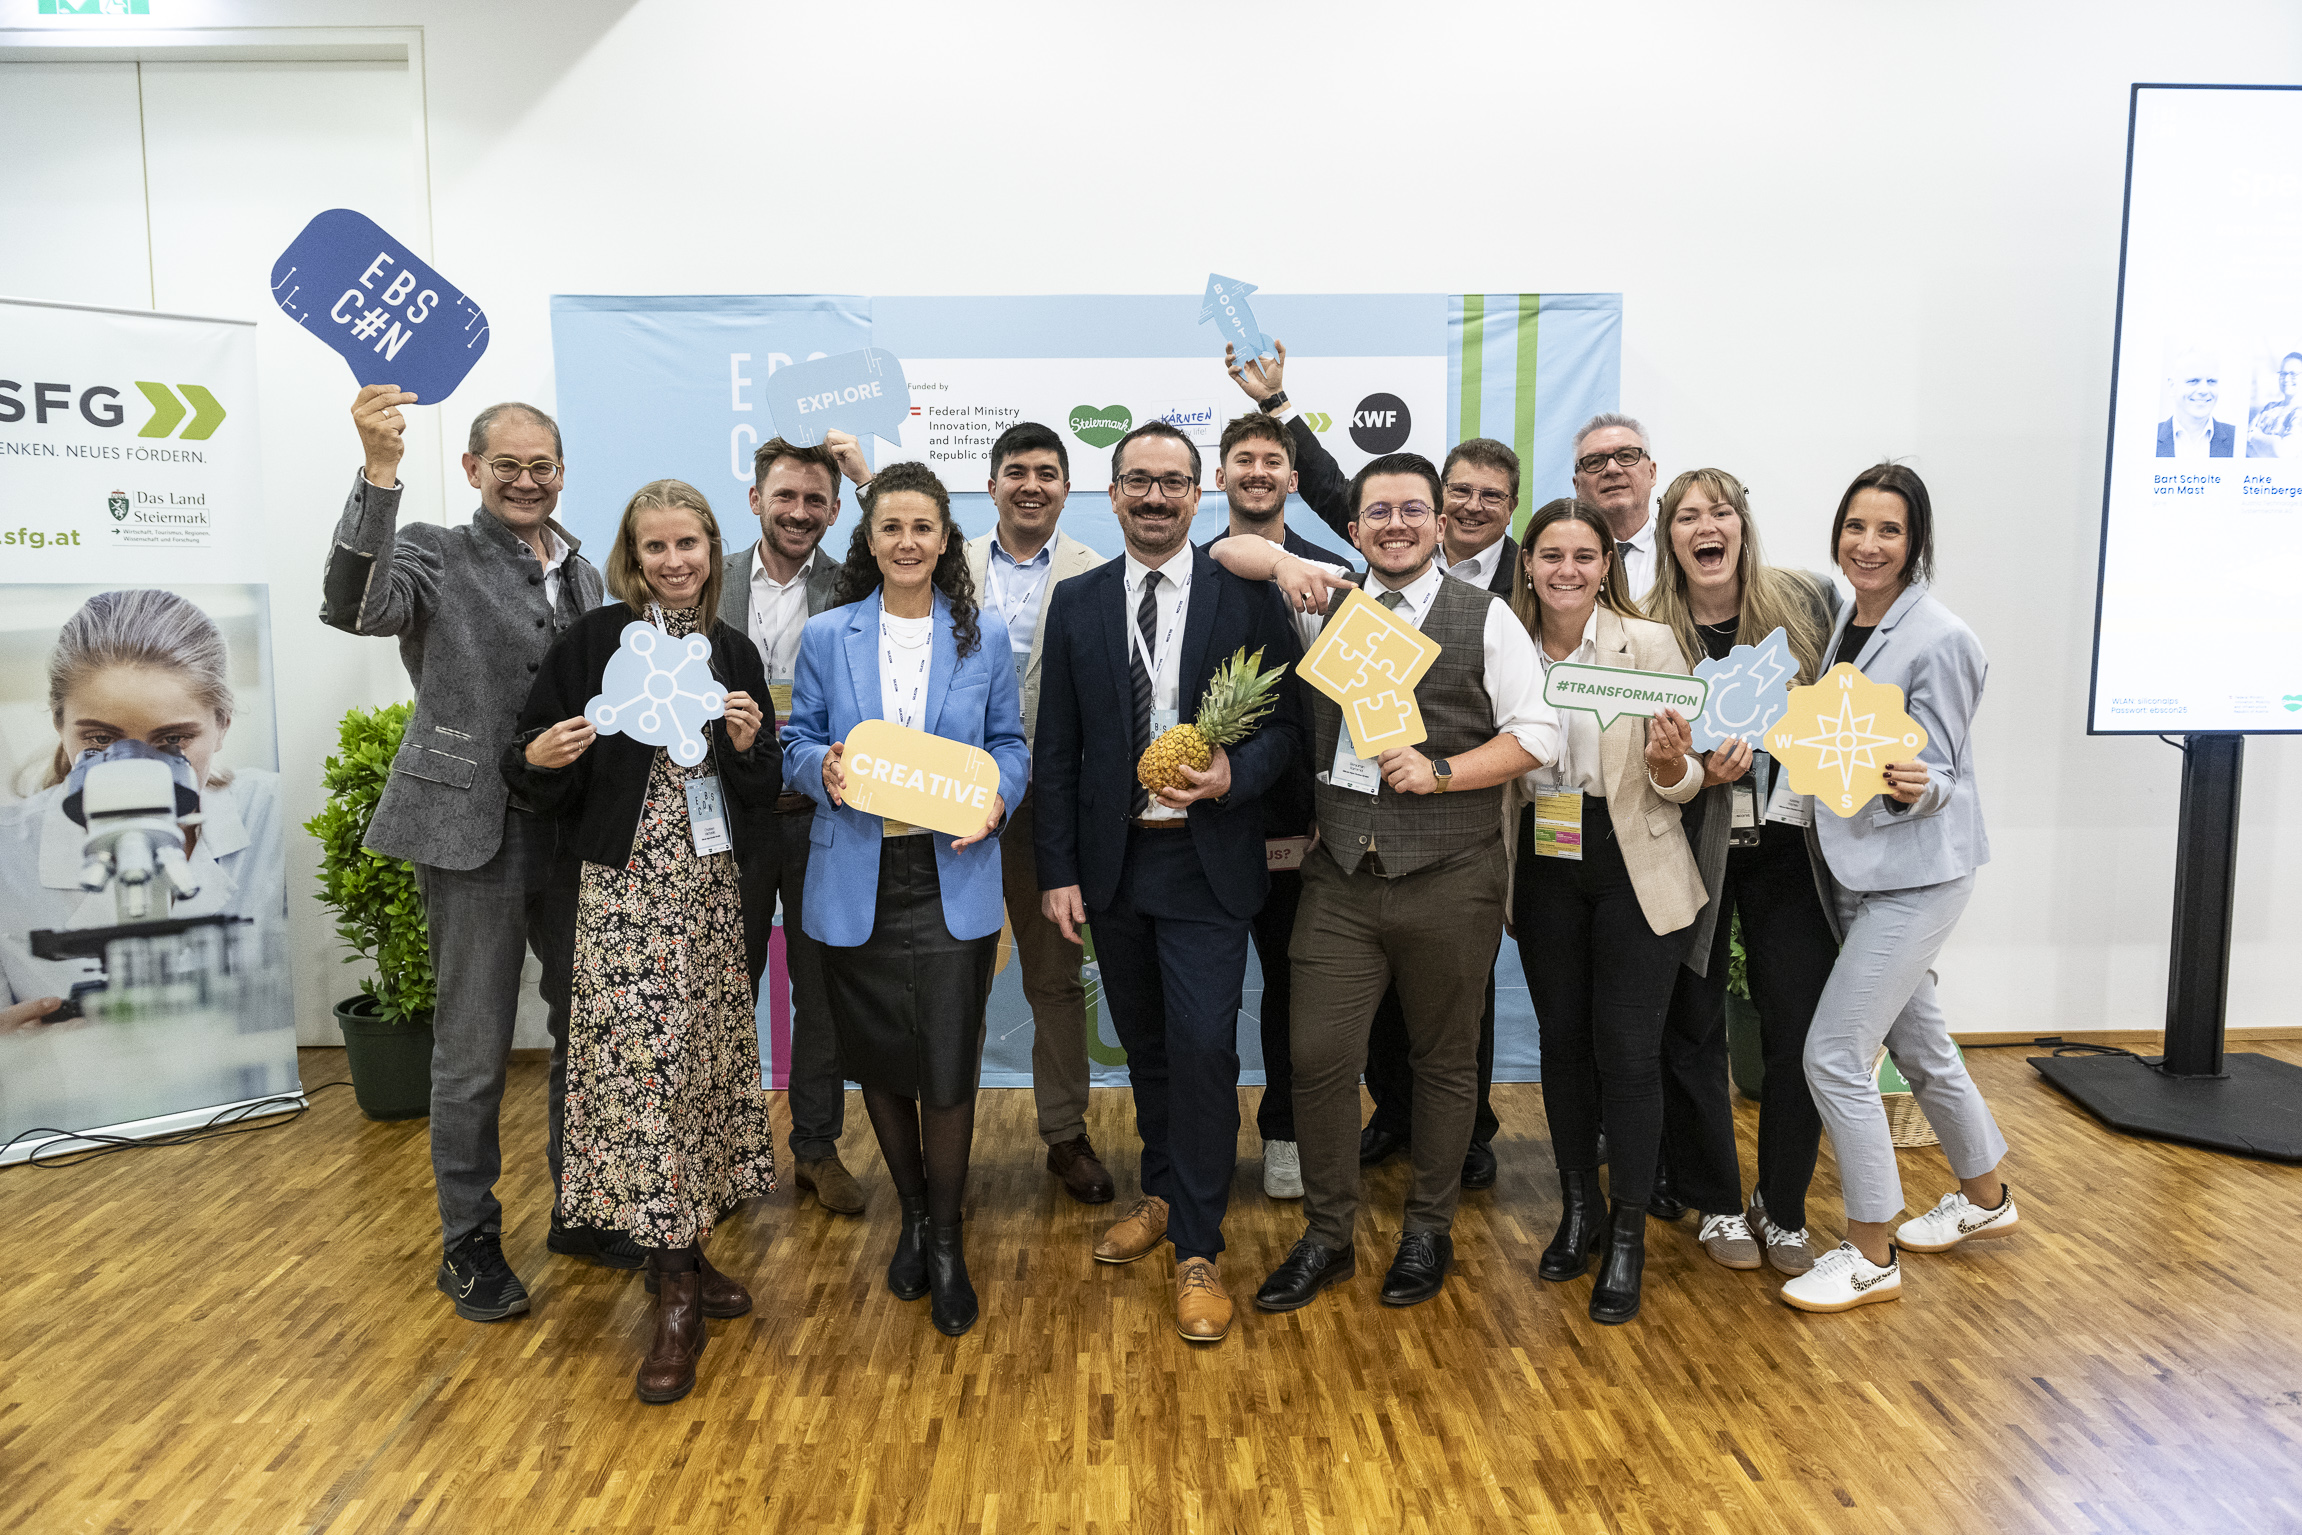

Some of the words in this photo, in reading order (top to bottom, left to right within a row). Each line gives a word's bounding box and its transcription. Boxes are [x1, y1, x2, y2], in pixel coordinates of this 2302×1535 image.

[358, 251, 439, 324] EBS
[1213, 283, 1247, 338] BOOST
[330, 288, 413, 362] C#N
[907, 382, 936, 390] Funded
[939, 382, 949, 391] by
[0, 379, 125, 427] SFG
[796, 380, 883, 415] EXPLORE
[929, 406, 970, 416] Federal
[974, 406, 1020, 418] Ministry
[1351, 410, 1397, 428] KWF
[929, 421, 991, 432] Innovation,
[1070, 417, 1131, 434] Steiermark
[1193, 427, 1207, 436] life!
[929, 435, 949, 445] and
[66, 444, 120, 459] NEUES
[126, 446, 207, 463] FÖRDERN.
[929, 450, 977, 462] Republic
[2154, 474, 2177, 484] Bart
[2180, 474, 2221, 484] Scholte
[2243, 474, 2272, 484] Anke
[137, 491, 164, 504] Das
[170, 492, 206, 505] Land
[2153, 487, 2175, 495] van
[2177, 486, 2205, 495] Mast
[134, 510, 207, 524] Steiermark
[1839, 674, 1853, 689] N
[1556, 680, 1698, 706] #TRANSFORMATION
[2149, 706, 2188, 714] ebscon25
[1774, 734, 1793, 749] W
[1902, 732, 1919, 748] O
[850, 753, 989, 809] CREATIVE
[1841, 793, 1853, 809] S
